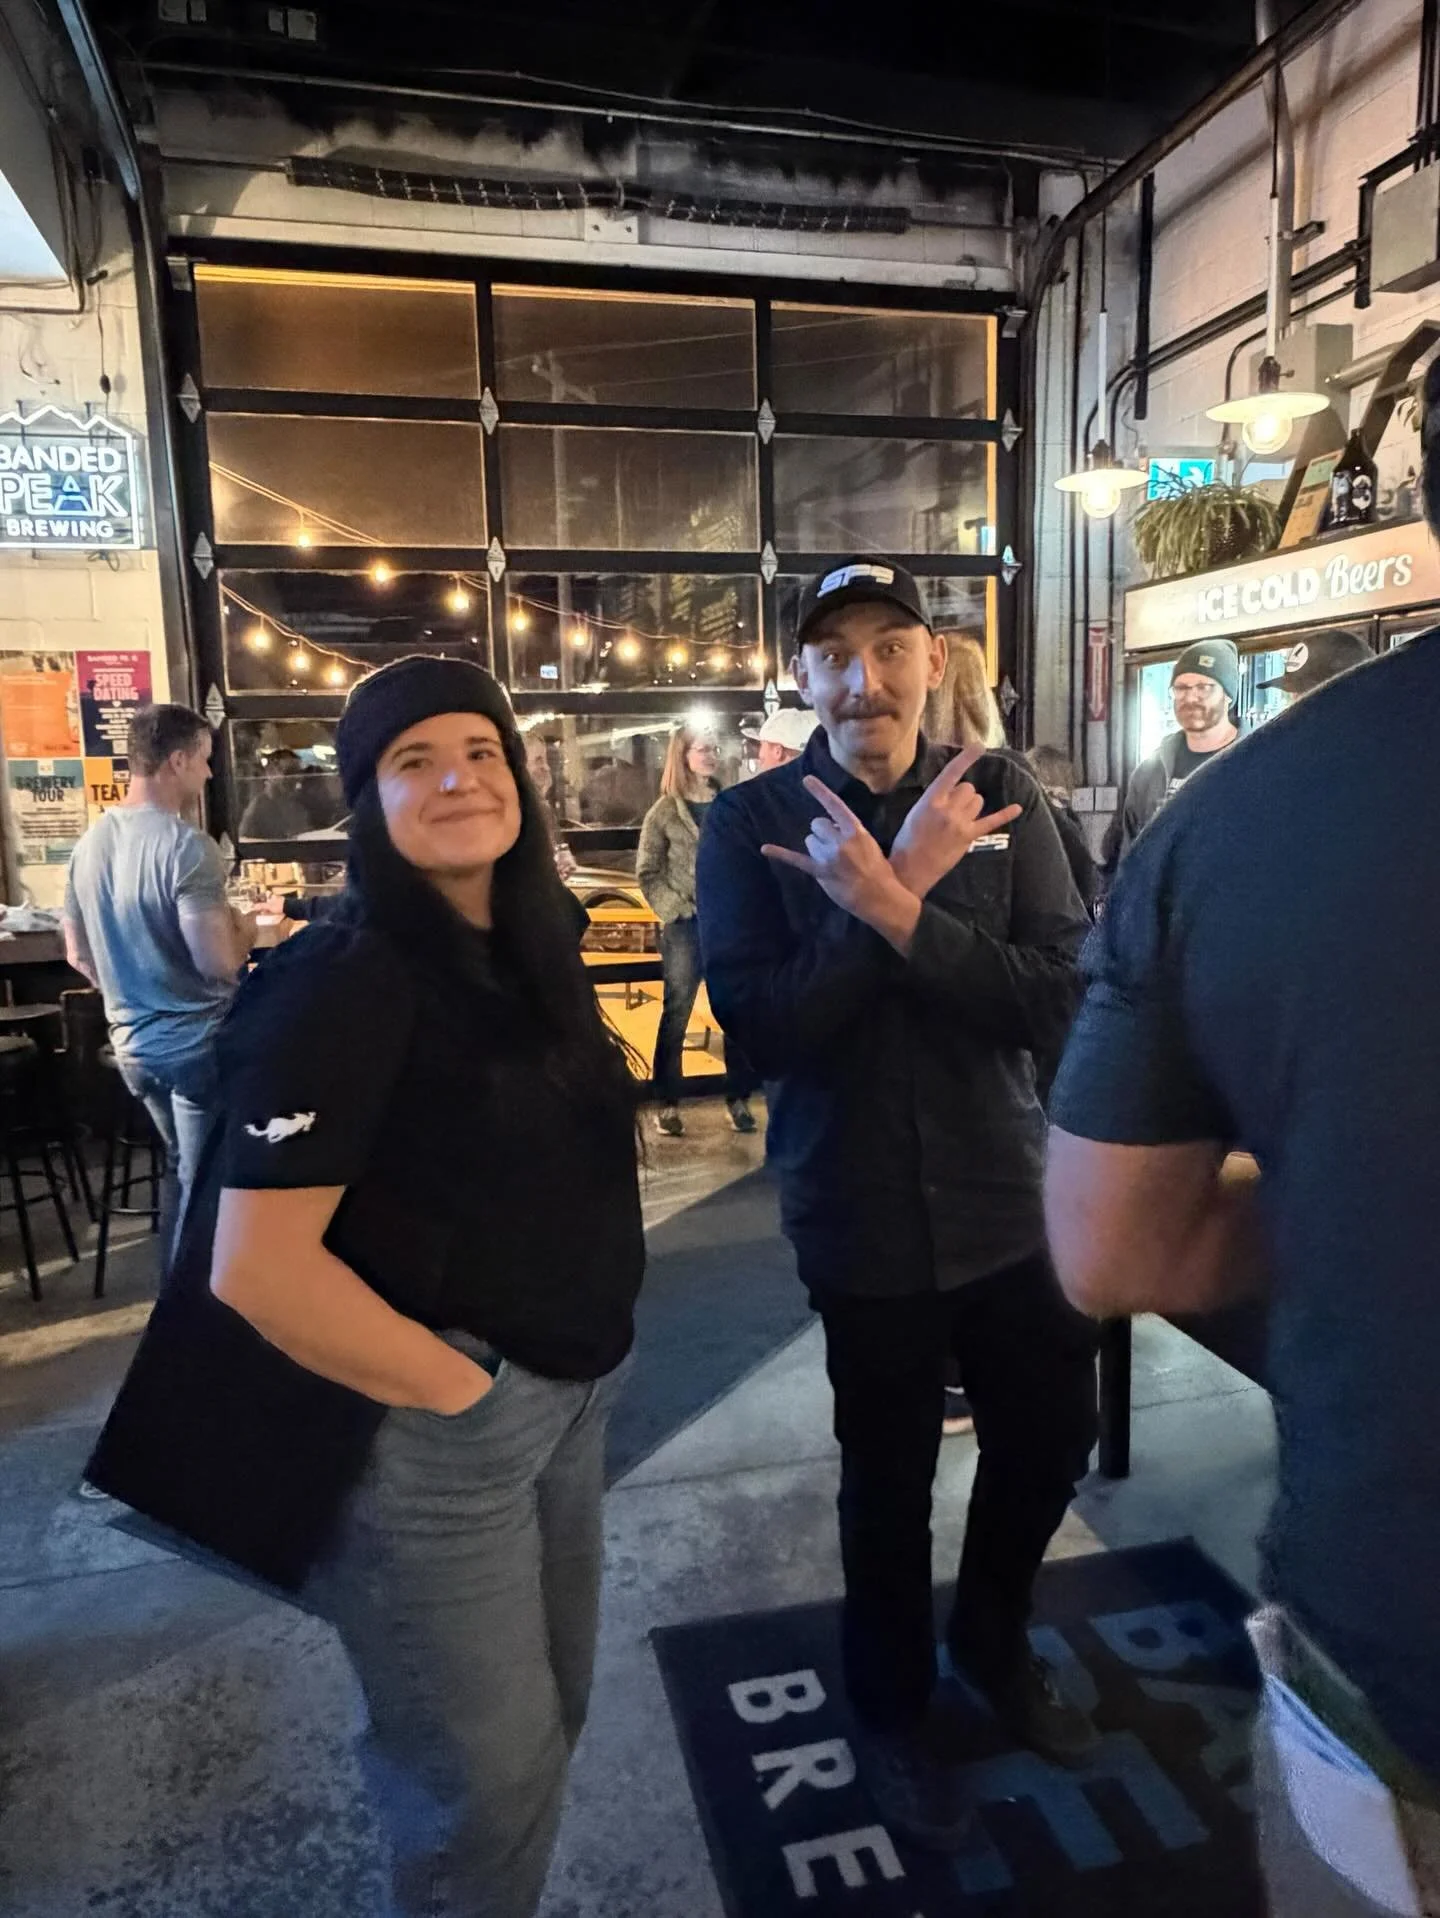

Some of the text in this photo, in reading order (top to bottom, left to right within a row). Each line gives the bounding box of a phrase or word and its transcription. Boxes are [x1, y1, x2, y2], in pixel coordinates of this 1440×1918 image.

[0, 444, 122, 473] BANDED
[0, 472, 128, 517] PEAK
[6, 518, 114, 537] BREWING
[1199, 554, 1413, 623] ICE COLD Beers
[94, 673, 133, 687] SPEED
[93, 687, 139, 700] DATING
[32, 788, 65, 802] TOUR
[91, 784, 121, 801] TEA
[727, 1669, 924, 1918] BRE
